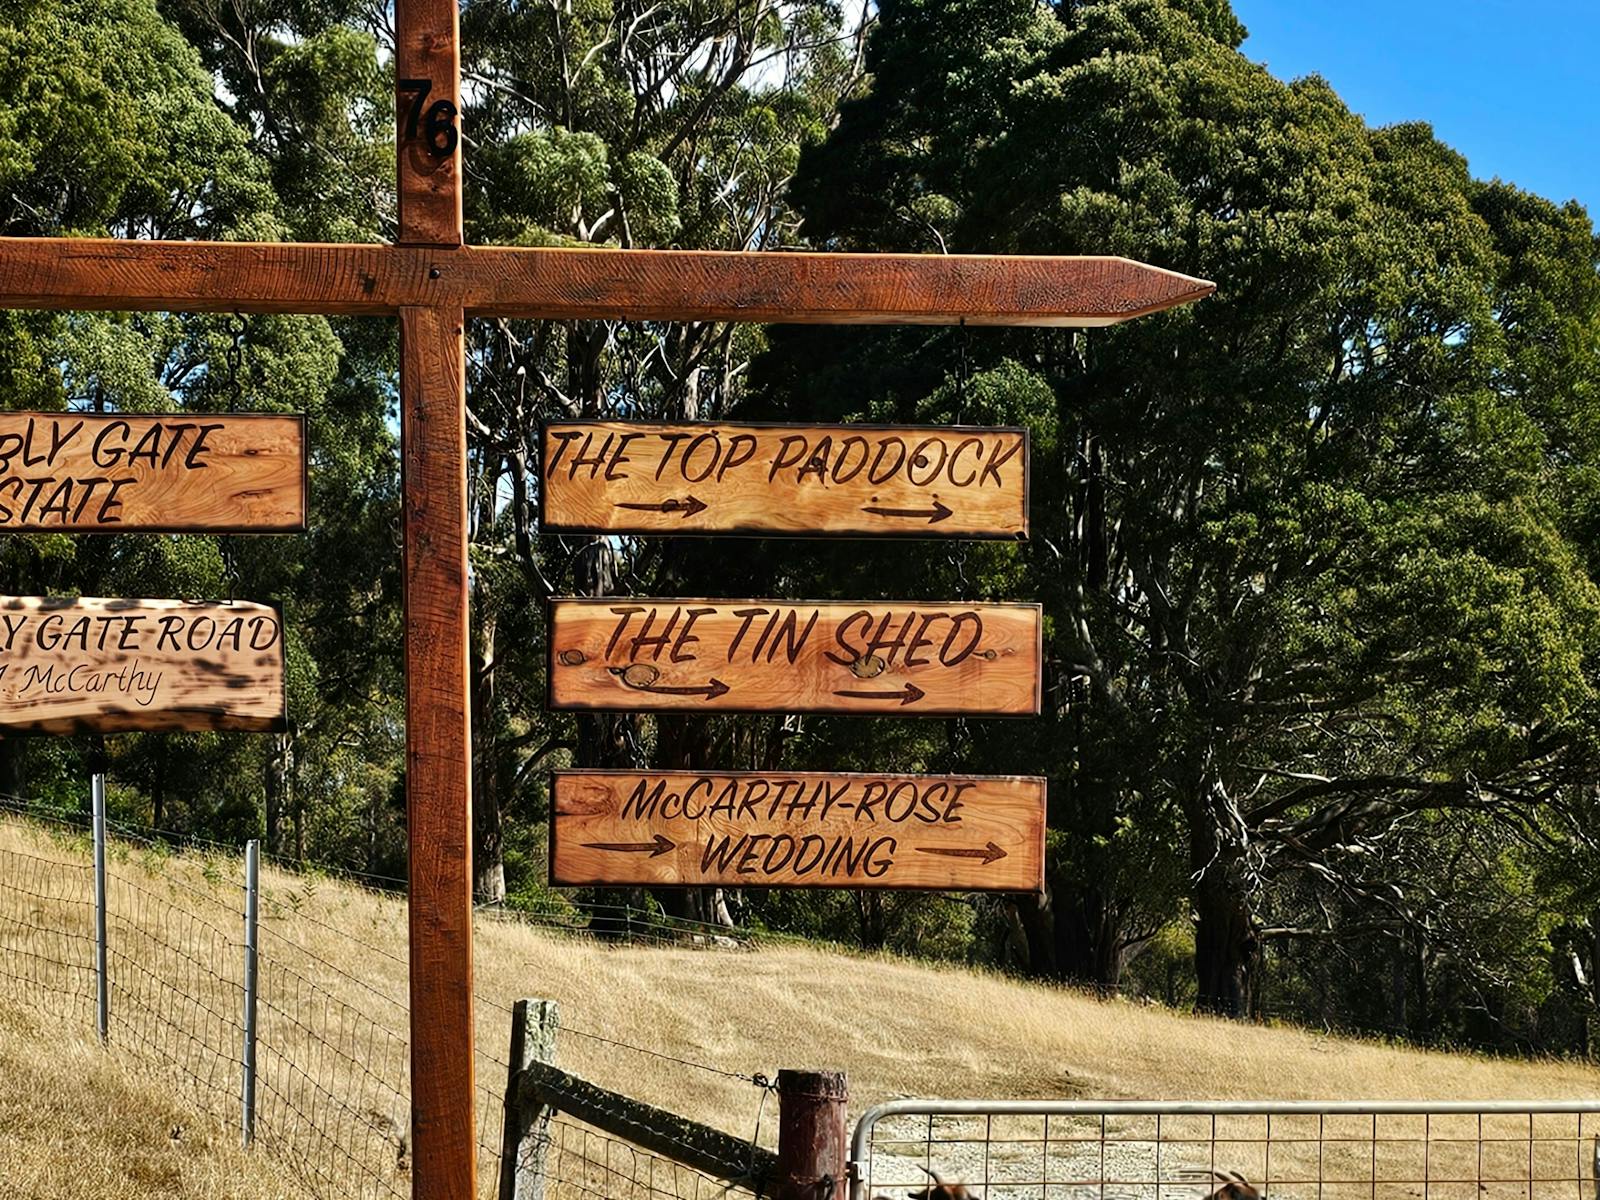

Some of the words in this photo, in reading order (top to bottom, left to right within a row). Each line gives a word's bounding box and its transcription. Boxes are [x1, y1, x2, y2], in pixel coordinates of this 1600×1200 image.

[399, 79, 458, 157] 76
[91, 421, 225, 469] GATE
[546, 431, 645, 481] THE
[656, 431, 757, 483] TOP
[769, 435, 1023, 488] PADDOCK
[36, 615, 147, 651] GATE
[157, 616, 279, 651] ROAD
[604, 607, 717, 664] THE
[727, 608, 819, 664] TIN
[823, 610, 984, 668] SHED
[19, 659, 163, 705] McCarthy
[621, 779, 976, 823] McCARTHY-ROSE
[699, 834, 897, 877] WEDDING
